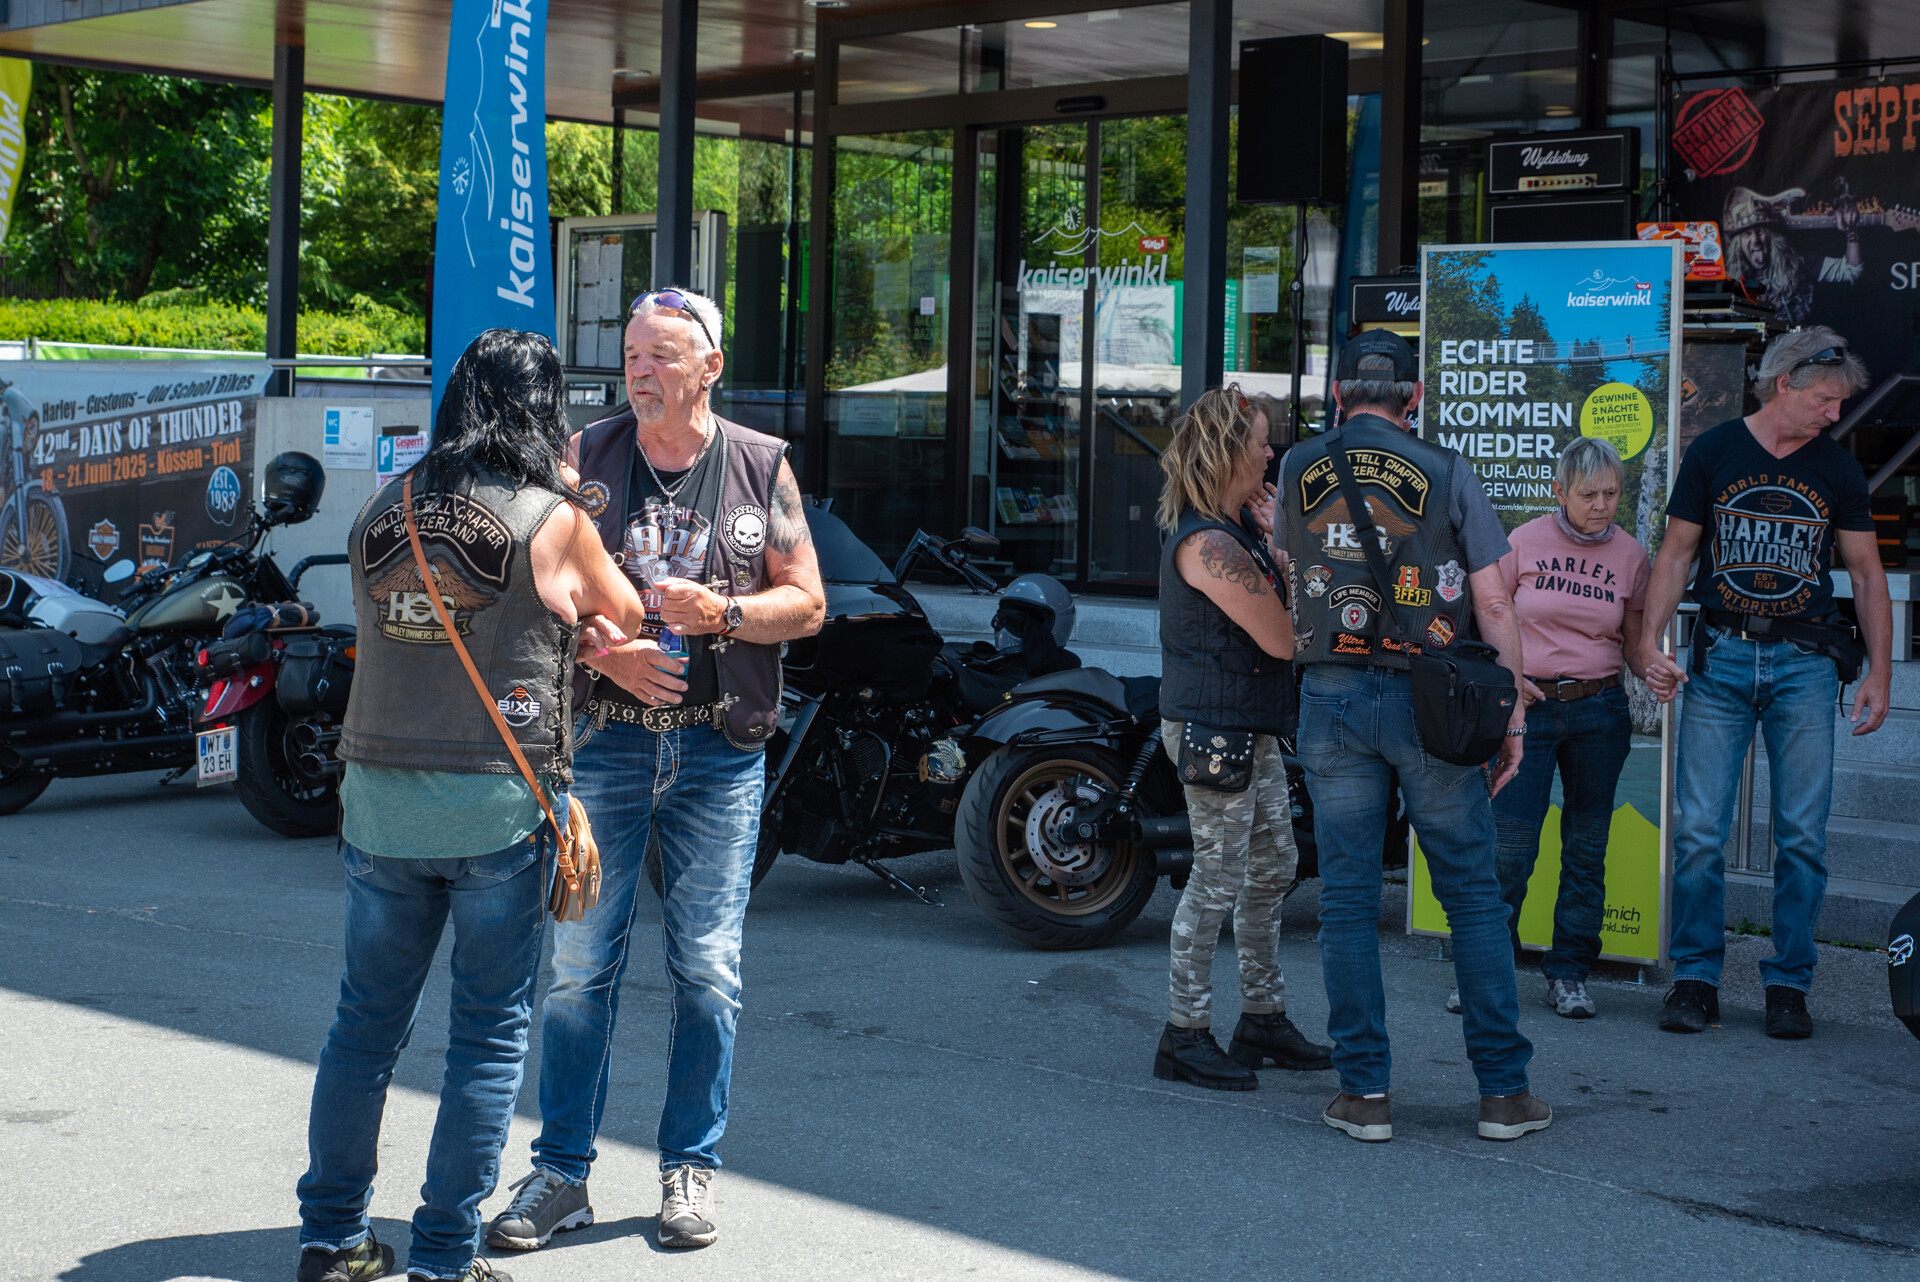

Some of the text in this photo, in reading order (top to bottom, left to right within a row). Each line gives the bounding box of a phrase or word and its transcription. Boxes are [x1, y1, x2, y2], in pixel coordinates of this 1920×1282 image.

[1677, 92, 1747, 155] CERTIFIED
[1691, 109, 1759, 172] ORIGINAL
[1016, 254, 1168, 292] kaiserwinkl
[1566, 290, 1651, 307] kaiserwinkl
[1441, 339, 1534, 365] ECHTE
[1440, 371, 1527, 396] RIDER
[42, 399, 76, 424] Harley
[86, 390, 137, 416] Customs
[147, 384, 171, 404] Old
[170, 376, 215, 401] School
[215, 373, 254, 395] Bikes
[1592, 392, 1638, 404] GEWINNE
[1592, 403, 1640, 415] 2 NÄCHTE
[128, 416, 151, 450] OF
[158, 400, 243, 446] THUNDER
[327, 418, 338, 427] WC
[1438, 402, 1572, 427] KOMMEN
[1593, 413, 1639, 424] IM HOTEL
[380, 440, 391, 465] P
[395, 437, 424, 449] Gesperrt
[1438, 434, 1562, 459] WIEDER.
[83, 459, 111, 485] Juni
[114, 453, 147, 481] 2025
[157, 448, 202, 475] Kössen
[211, 437, 241, 466] Tirol
[1355, 453, 1380, 465] TELL
[1384, 458, 1426, 492] CHAPTER
[1482, 464, 1556, 481] URLAUB,
[211, 490, 236, 512] 1983
[1482, 482, 1556, 498] GEWINN.
[1717, 474, 1830, 517] WORLD FAMOUS
[456, 505, 505, 550] CHAPTER
[1719, 540, 1812, 576] DAVIDSON
[1536, 557, 1616, 586] HARLEY-
[1755, 572, 1778, 581] EST.
[1333, 588, 1378, 604] LIFE MEMBER
[1535, 575, 1615, 603] DAVIDSON
[1717, 582, 1812, 612] MOTORCYCLES
[1753, 580, 1778, 589] 1903
[385, 623, 451, 640] HARLEY OWNERS GRO
[1338, 633, 1365, 645] Ultra
[1382, 638, 1401, 650] Road
[207, 735, 221, 753] WT
[203, 753, 231, 774] 23 EH
